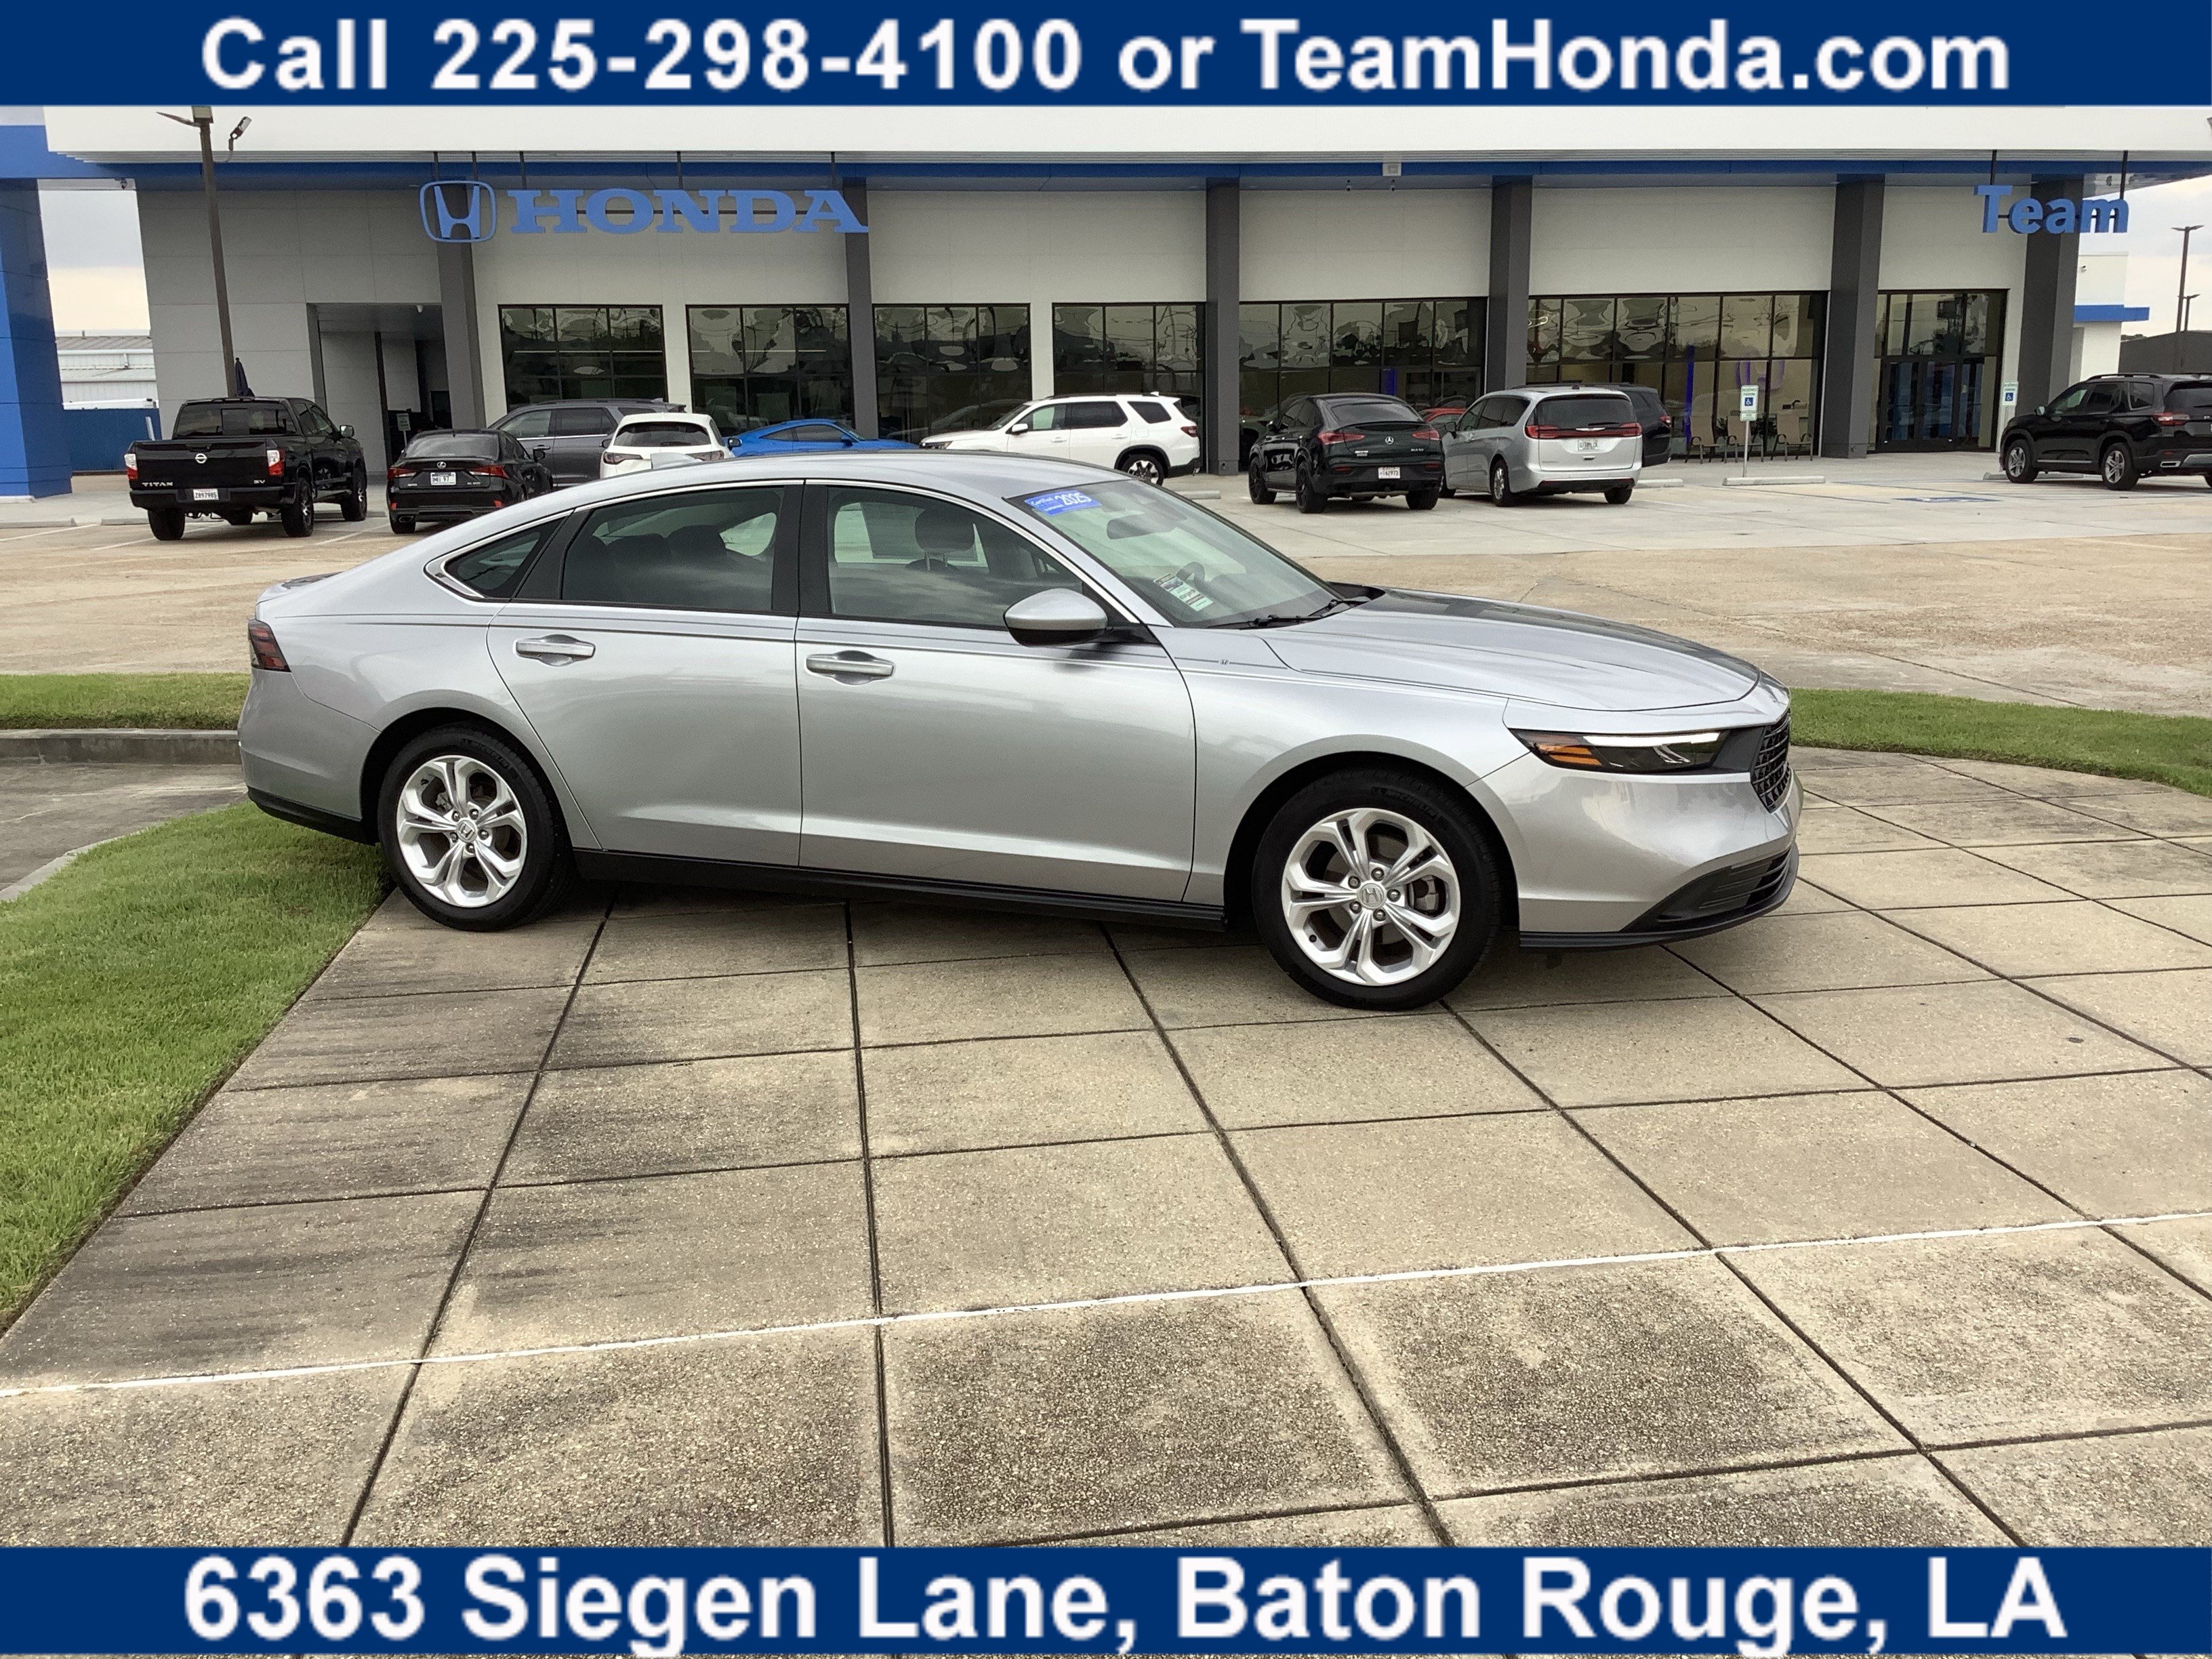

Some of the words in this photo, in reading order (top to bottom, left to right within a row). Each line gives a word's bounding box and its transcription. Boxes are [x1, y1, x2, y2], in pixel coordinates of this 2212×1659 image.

[508, 188, 869, 234] HONDA
[1973, 184, 2129, 234] Team
[1054, 492, 1092, 506] 2025
